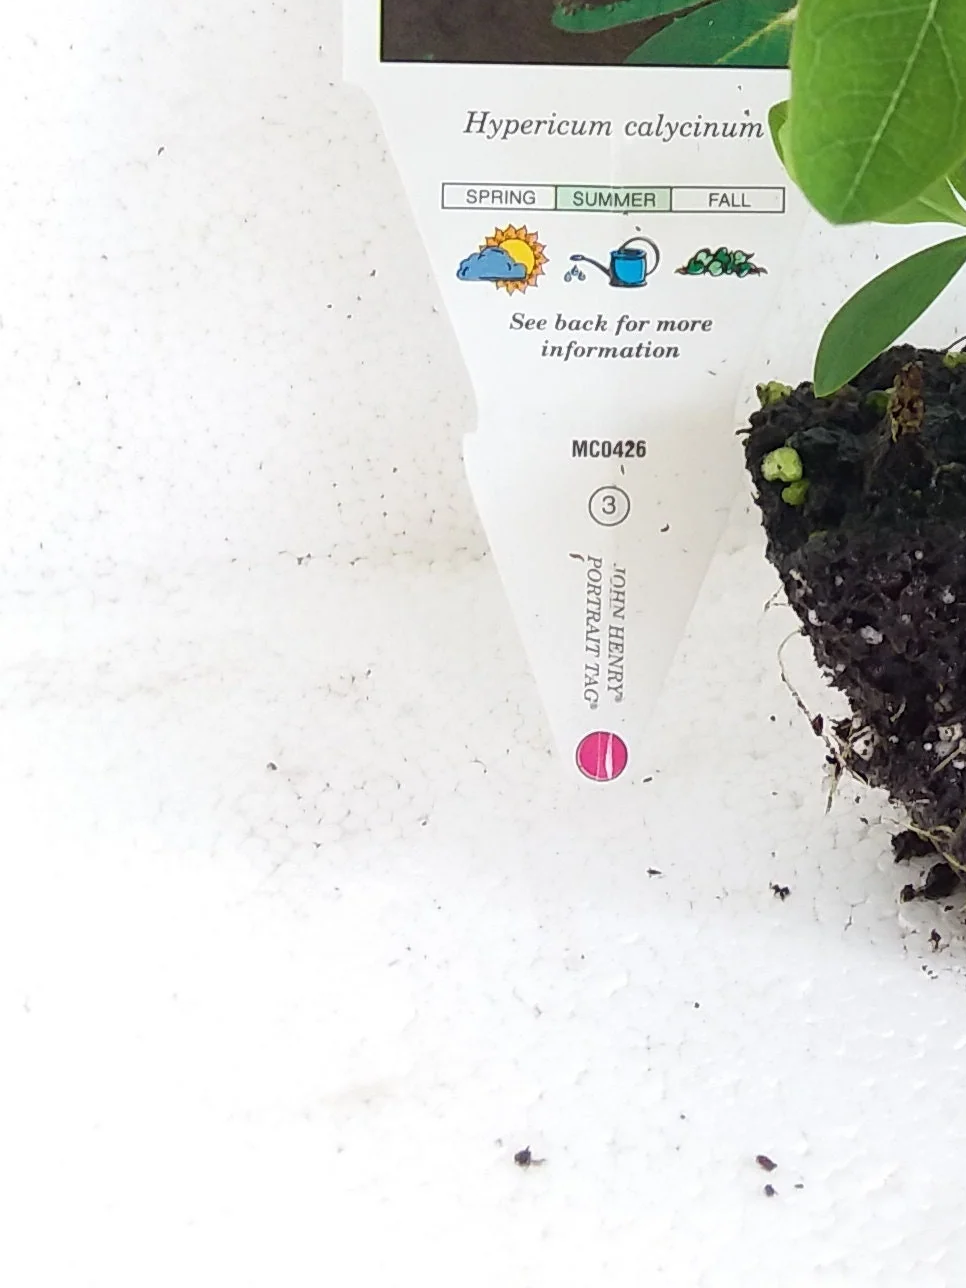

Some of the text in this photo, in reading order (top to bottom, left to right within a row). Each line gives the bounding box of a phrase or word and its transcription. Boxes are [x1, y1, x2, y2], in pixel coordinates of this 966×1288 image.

[463, 111, 765, 142] Hypericum calycinum
[466, 189, 751, 208] SPRING SUMMER FALL
[509, 313, 713, 334] See back for more
[541, 340, 680, 360] information
[601, 496, 617, 514] 3
[608, 562, 626, 620] JOHN
[585, 555, 602, 660] PORTRAIT
